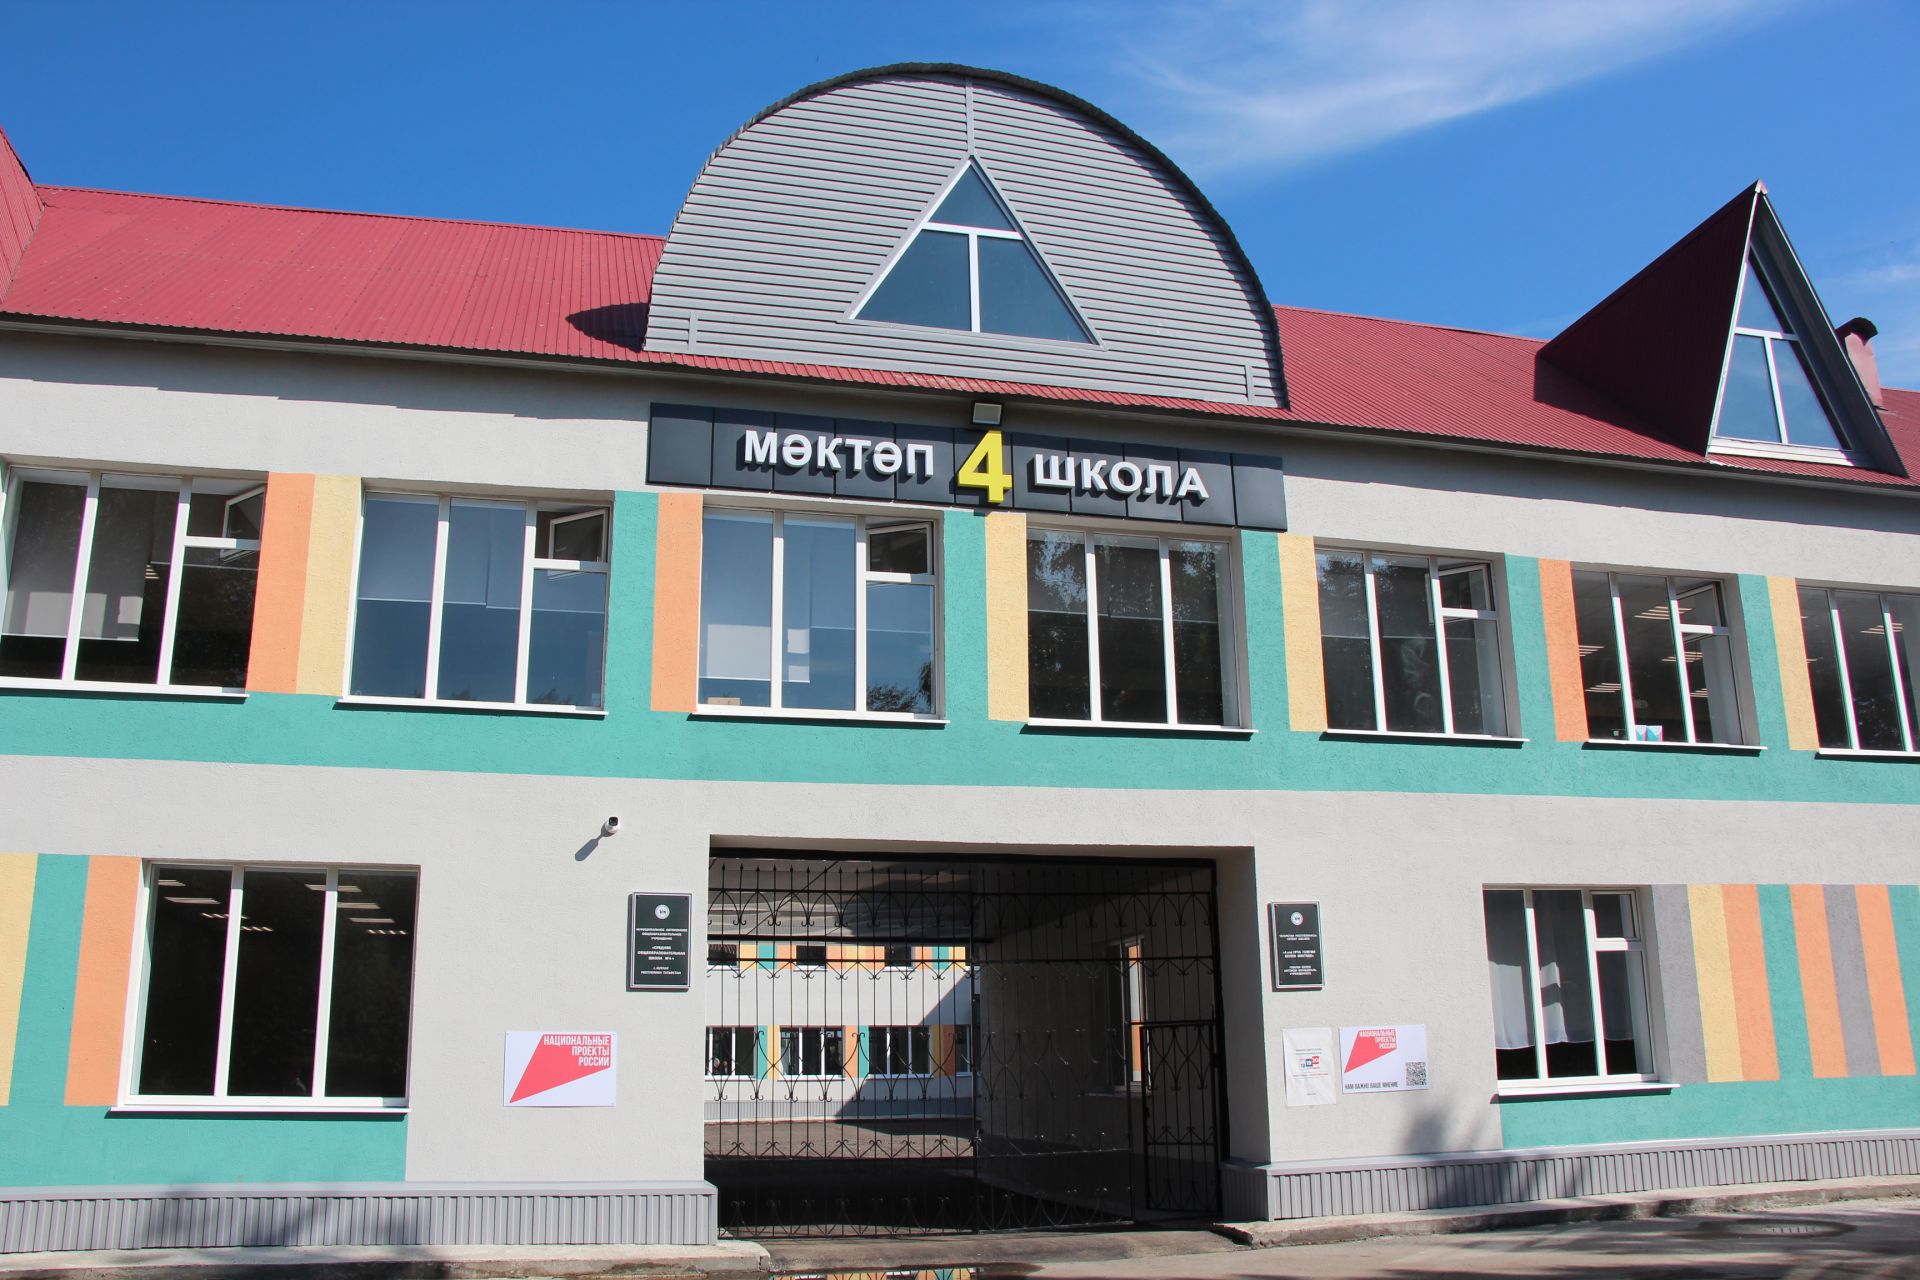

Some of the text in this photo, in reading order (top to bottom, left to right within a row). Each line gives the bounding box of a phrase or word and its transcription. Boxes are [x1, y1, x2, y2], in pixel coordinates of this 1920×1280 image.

[744, 430, 1209, 503] МӘКТӘП 4 ШКОЛА
[543, 1035, 610, 1046] НАЦИОНАЛЬНЫЕ
[571, 1046, 610, 1056] ПРОЕКТЫ
[578, 1056, 609, 1066] РОССИИ
